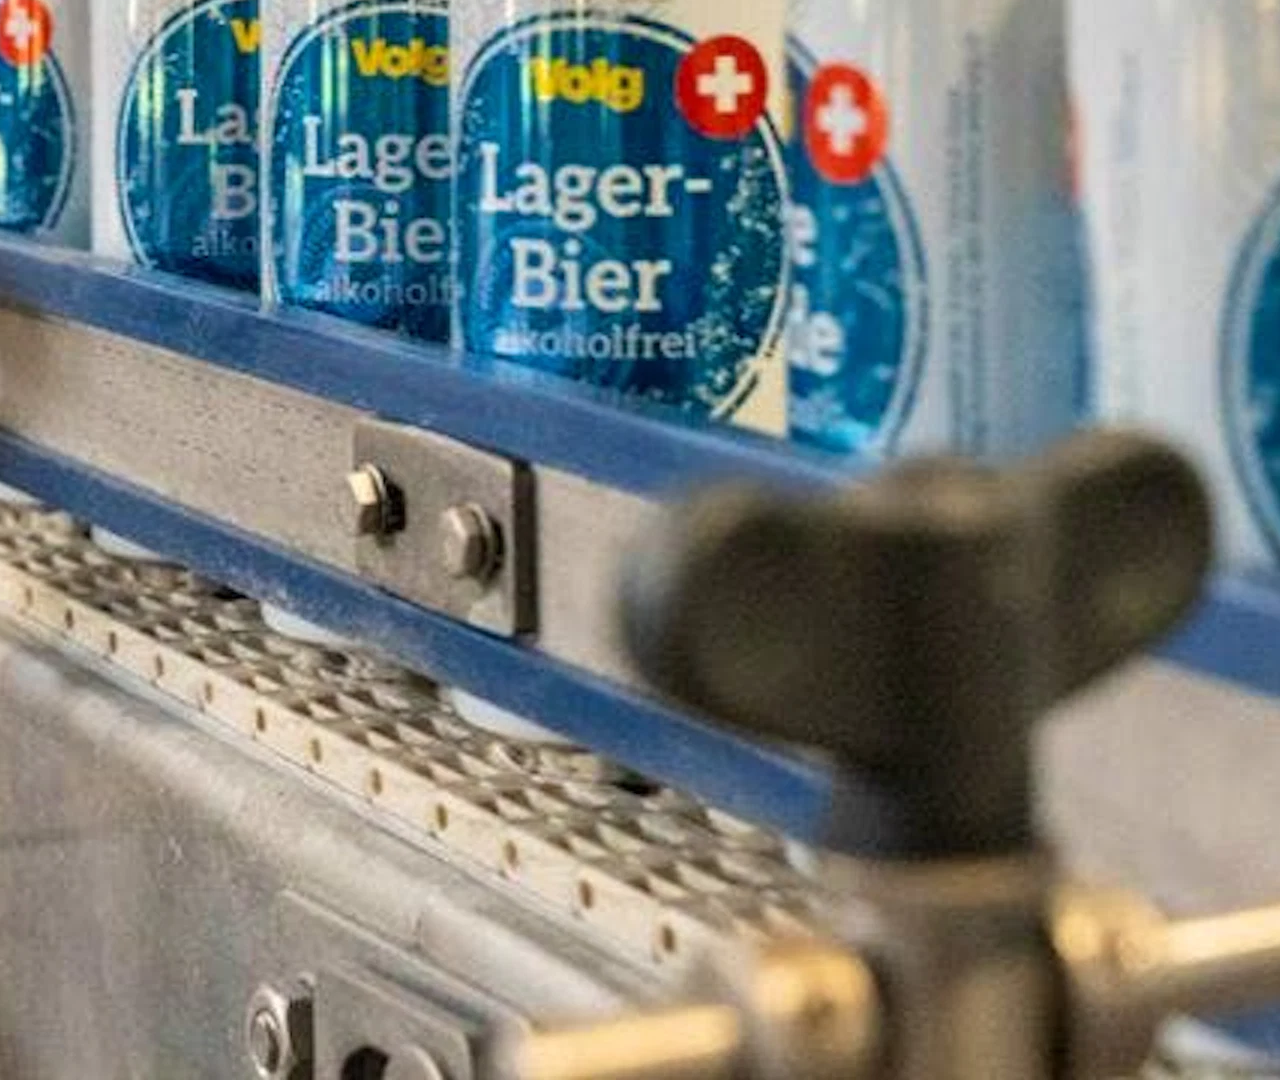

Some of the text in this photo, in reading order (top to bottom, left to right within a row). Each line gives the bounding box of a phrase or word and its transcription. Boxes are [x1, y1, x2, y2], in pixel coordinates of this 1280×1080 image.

[530, 57, 646, 113] Volg
[303, 115, 452, 193] Lage
[478, 141, 713, 232] Lager-
[332, 199, 447, 264] Bie
[510, 238, 672, 313] Bier
